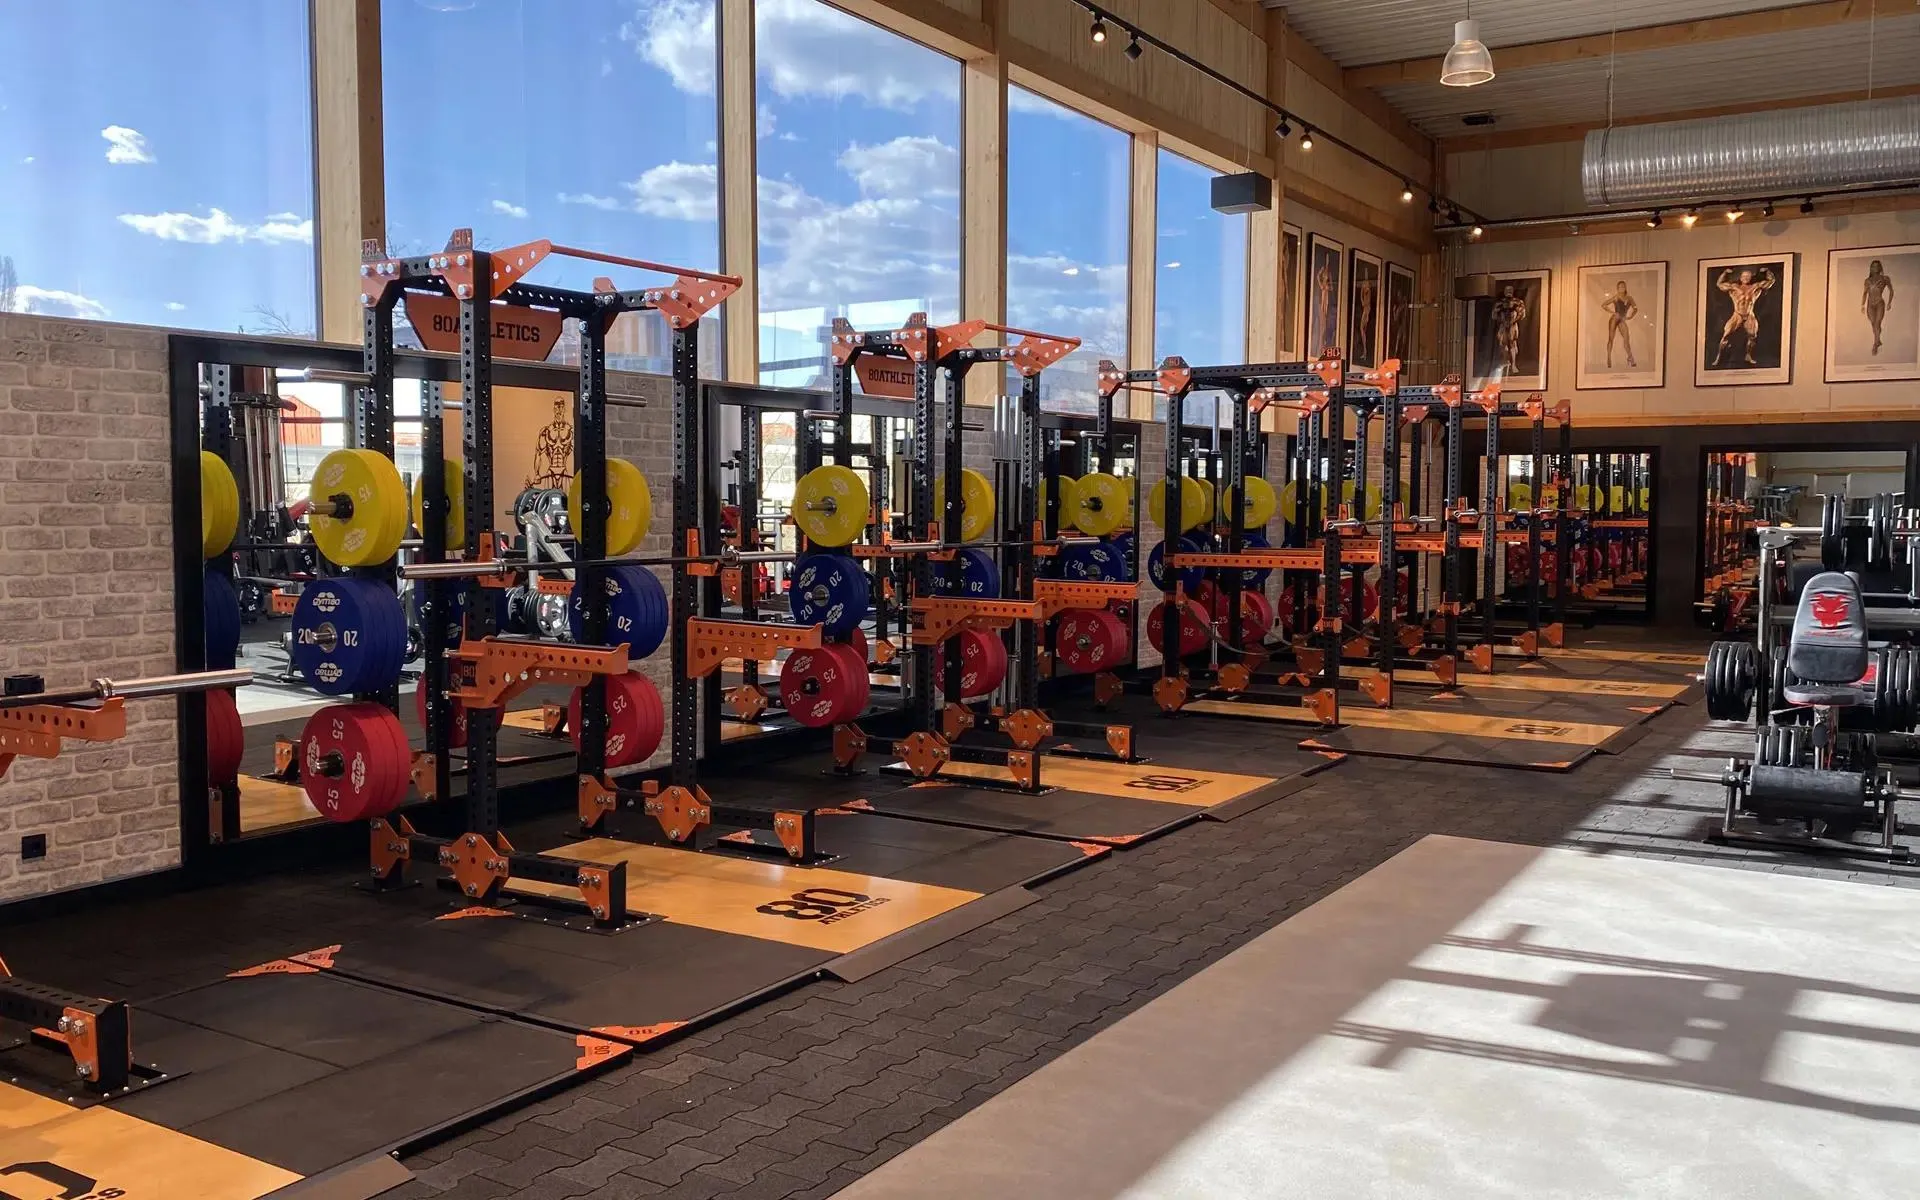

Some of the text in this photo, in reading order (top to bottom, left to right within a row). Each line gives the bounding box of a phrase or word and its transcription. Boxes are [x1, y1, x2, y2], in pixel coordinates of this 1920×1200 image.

[433, 314, 541, 343] 80AETICS
[829, 570, 842, 588] 20
[971, 581, 984, 593] 20
[801, 604, 813, 621] 20
[617, 615, 633, 632] 20
[298, 628, 312, 644] 20
[343, 630, 358, 647] 20
[966, 644, 980, 658] 25
[823, 668, 837, 685] 25
[613, 694, 628, 715] 25
[787, 689, 801, 706] 25
[332, 718, 344, 741] 25
[327, 788, 339, 811] 25
[755, 888, 871, 920] 80
